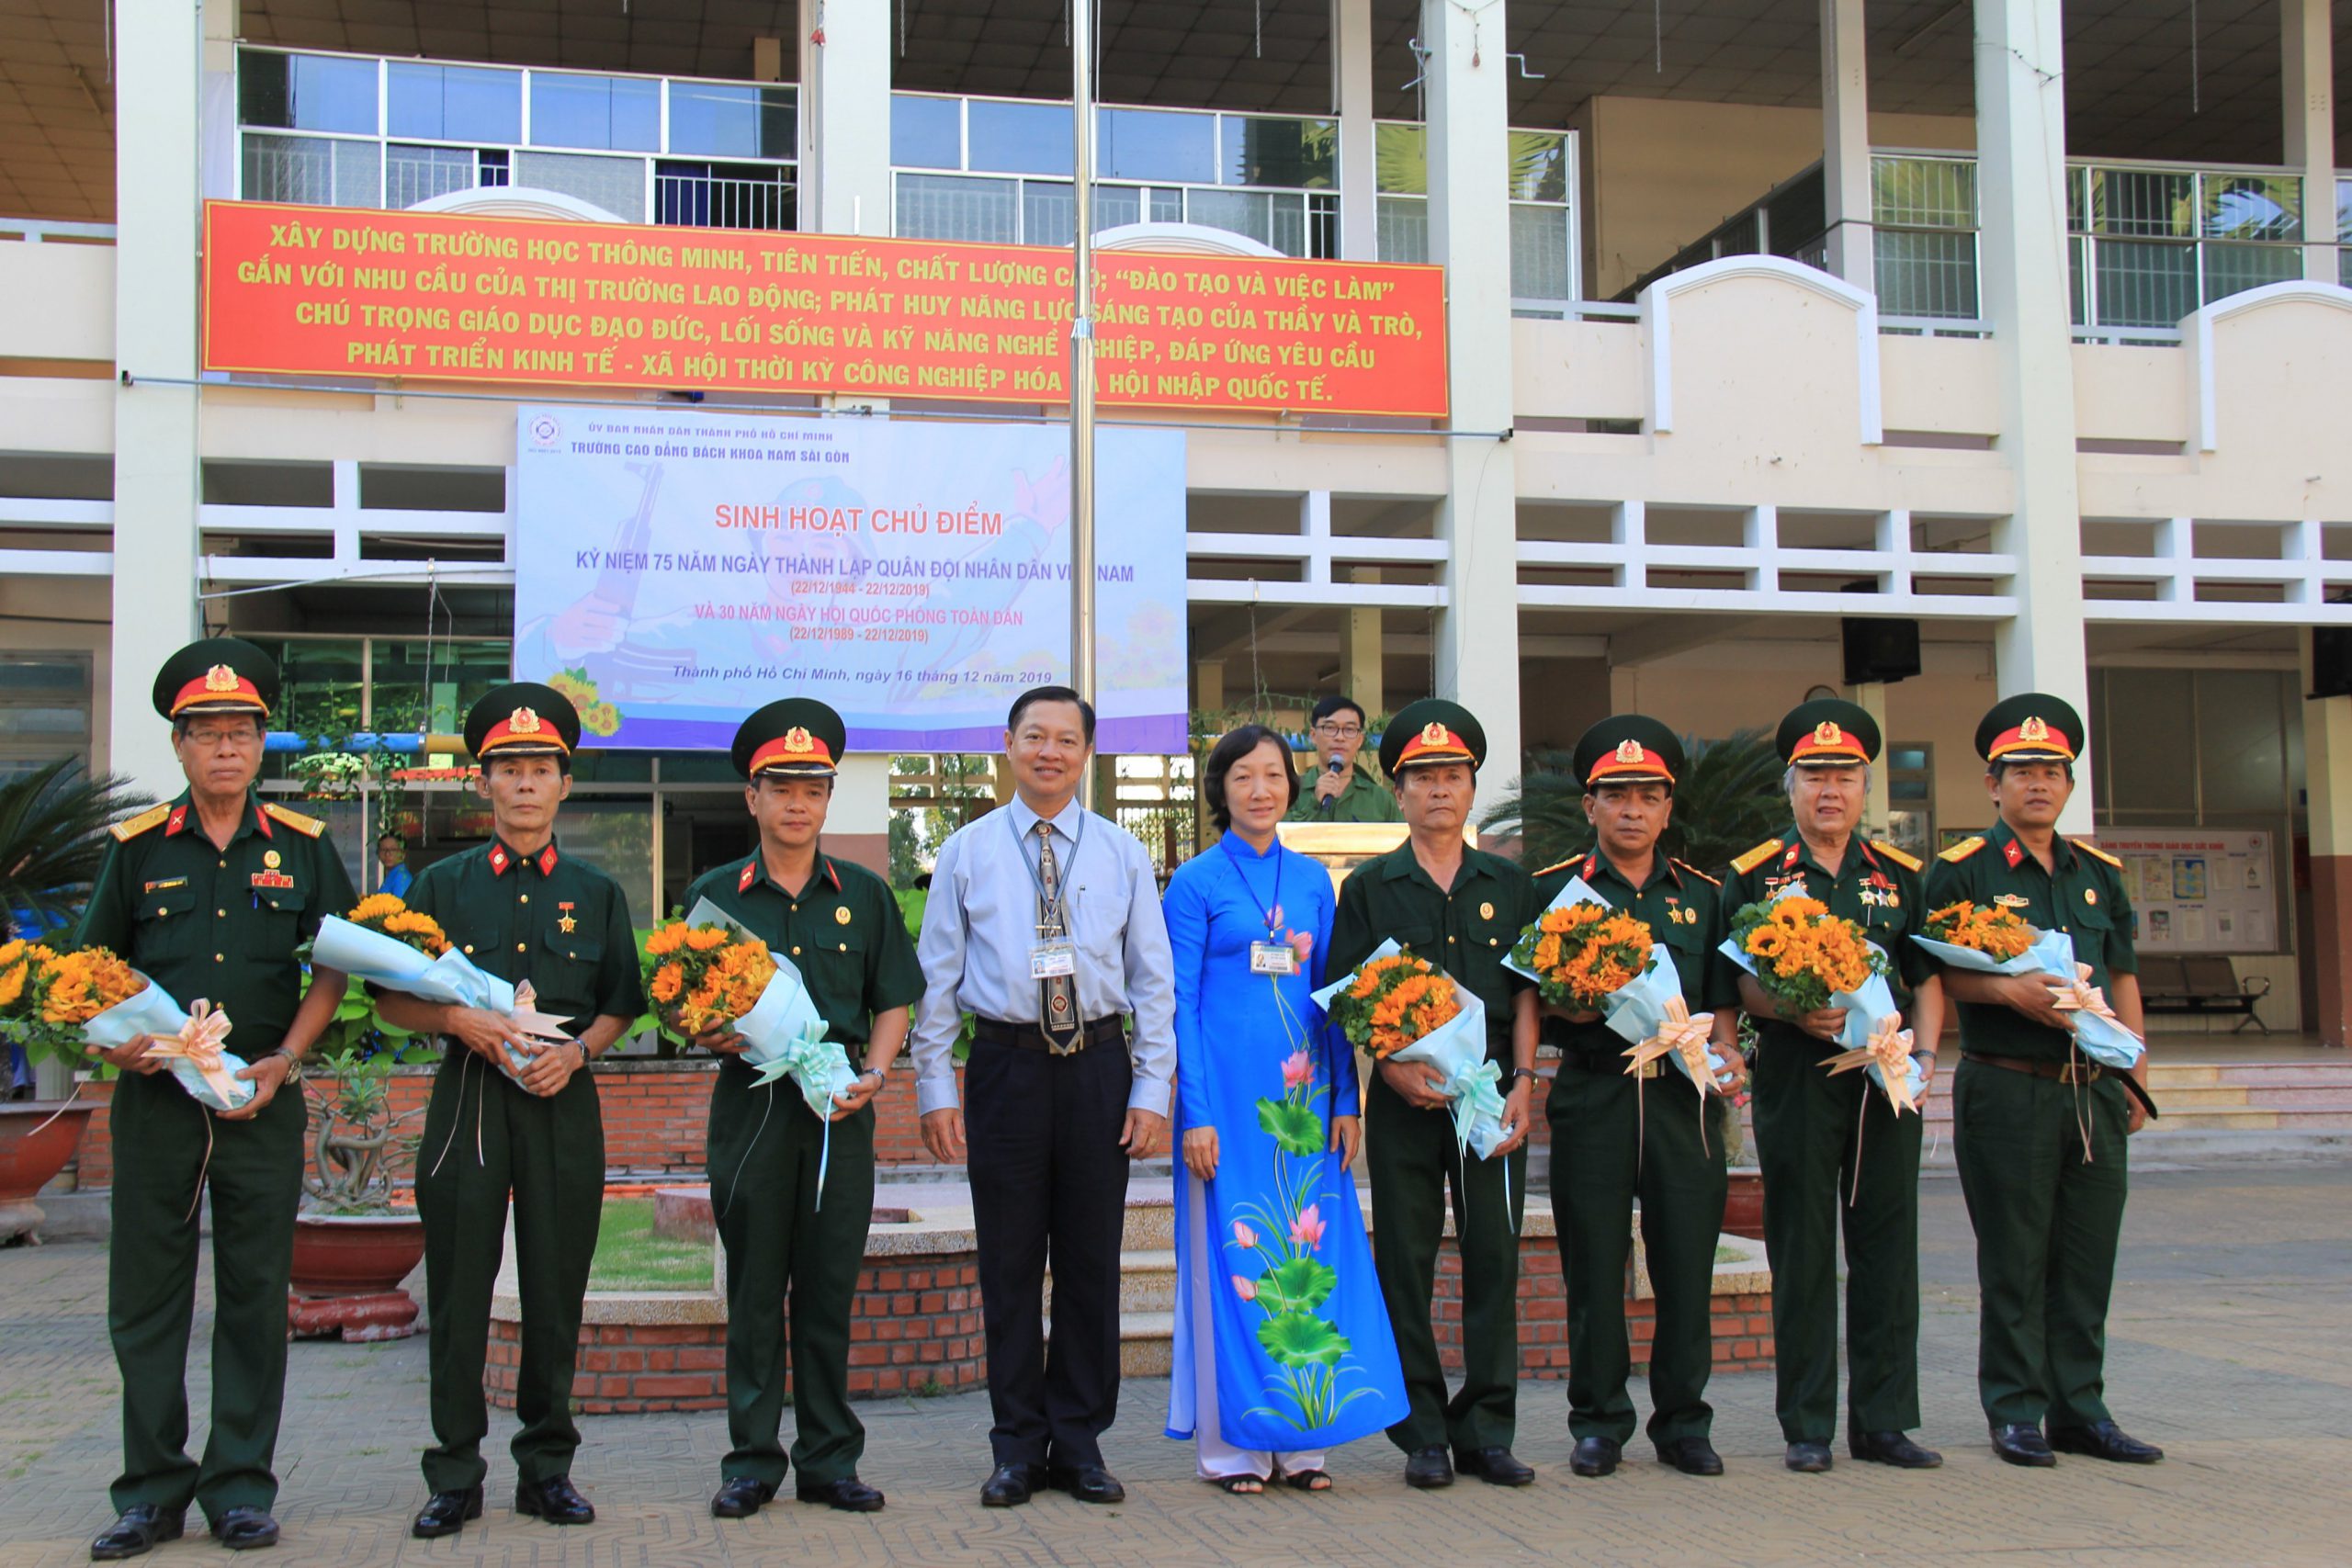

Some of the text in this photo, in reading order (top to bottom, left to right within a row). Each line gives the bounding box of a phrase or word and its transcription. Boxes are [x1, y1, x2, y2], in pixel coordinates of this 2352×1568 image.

[270, 220, 322, 248] XÂY
[333, 226, 404, 254] DỰNG
[413, 231, 518, 259] TRƯỜNG
[527, 239, 580, 265] HỌC
[587, 240, 673, 267] THÔNG
[682, 247, 752, 275] MINH,
[761, 248, 817, 274] TIÊN
[825, 249, 888, 281] TIẾN,
[897, 254, 959, 281] CHẤT
[969, 261, 1046, 288] LƯỢNG
[1055, 266, 1107, 292] CO;
[1184, 273, 1230, 297] TẠO
[1238, 270, 1266, 295] VÀ
[1274, 273, 1326, 300] VIỆC
[238, 254, 291, 287] GẮN
[300, 261, 345, 288] VỚI
[354, 267, 406, 290] NHU
[415, 263, 466, 293] CẦU
[475, 266, 526, 297] CỦA
[535, 276, 576, 303] THỊ
[584, 277, 684, 304] TRƯỜNG
[693, 285, 740, 306] LAO
[748, 283, 822, 315] ĐỘNG;
[831, 288, 894, 313] PHÁT
[904, 294, 952, 317] HUY
[961, 294, 1024, 320] NĂNG
[1157, 306, 1203, 331] TẠO
[1210, 301, 1257, 329] CỦA
[1264, 304, 1325, 333] THẦY
[1332, 309, 1362, 333] VÀ
[1369, 311, 1422, 340] TRÒ,
[296, 298, 350, 325] CHÚ
[360, 304, 450, 333] TRỌNG
[458, 306, 520, 333] GIÁO
[528, 312, 582, 339] DỤC
[591, 316, 643, 342] ĐẠO
[651, 314, 711, 345] ĐỨC,
[720, 315, 761, 344] LỐI
[769, 318, 834, 346] SỐNG
[842, 323, 873, 349] VÀ
[883, 326, 914, 350] KỸ
[925, 328, 989, 354] NĂNG
[997, 328, 1058, 356] NGHỀ
[1170, 337, 1216, 362] ĐÁP
[1224, 338, 1270, 366] ỨNG
[1278, 342, 1322, 367] YÊU
[1330, 341, 1374, 368] CẦU
[347, 338, 416, 366] PHÁT
[425, 337, 503, 368] TRIỂN
[513, 349, 573, 372] KINH
[582, 345, 618, 374] TẾ
[642, 351, 673, 376] XÃ
[684, 353, 726, 381] HỘI
[735, 355, 793, 380] THỜI
[802, 355, 833, 382] KỲ
[844, 358, 910, 386] CÔNG
[918, 363, 1006, 392] NGHIỆP
[1014, 366, 1062, 391] HÓA
[1109, 369, 1148, 398] HỘI
[1158, 372, 1220, 400] NHẬP
[1227, 372, 1288, 400] QUỐC
[1296, 374, 1333, 401] TẾ.
[571, 441, 621, 455] TRƯỜNG
[625, 444, 650, 456] CAO
[693, 446, 726, 458] BÁCH
[730, 447, 763, 460] KHOA
[767, 449, 796, 461] NAM
[800, 448, 820, 462] SÀI
[825, 449, 850, 463] GÒN
[715, 501, 1002, 537] SINH HOẠT CHỦ ĐIỂM
[653, 554, 673, 570] 75
[677, 550, 717, 571] NĂM
[721, 551, 770, 573] NGÀY
[775, 553, 834, 575] THÀNH
[876, 556, 926, 578] QUÂN
[930, 558, 959, 581] ĐỘI
[965, 558, 1011, 580] NHÂN
[1017, 558, 1051, 581] DÂN
[1097, 564, 1134, 582] NAM
[791, 581, 855, 595] (22/12/1944
[865, 582, 930, 597] 22/12/2019)
[695, 601, 715, 619] VÀ
[719, 604, 735, 620] 30
[739, 602, 771, 621] NĂM
[775, 603, 817, 622] NGÀY
[820, 605, 845, 625] HỘI
[950, 606, 989, 626] TOÀN
[789, 626, 854, 641] (22/12/1989
[865, 628, 929, 643] 22/12/2019)
[673, 663, 1052, 684] Thành phố Hồ Chí Minh, ngày 16 tháng 12 năm 2019
